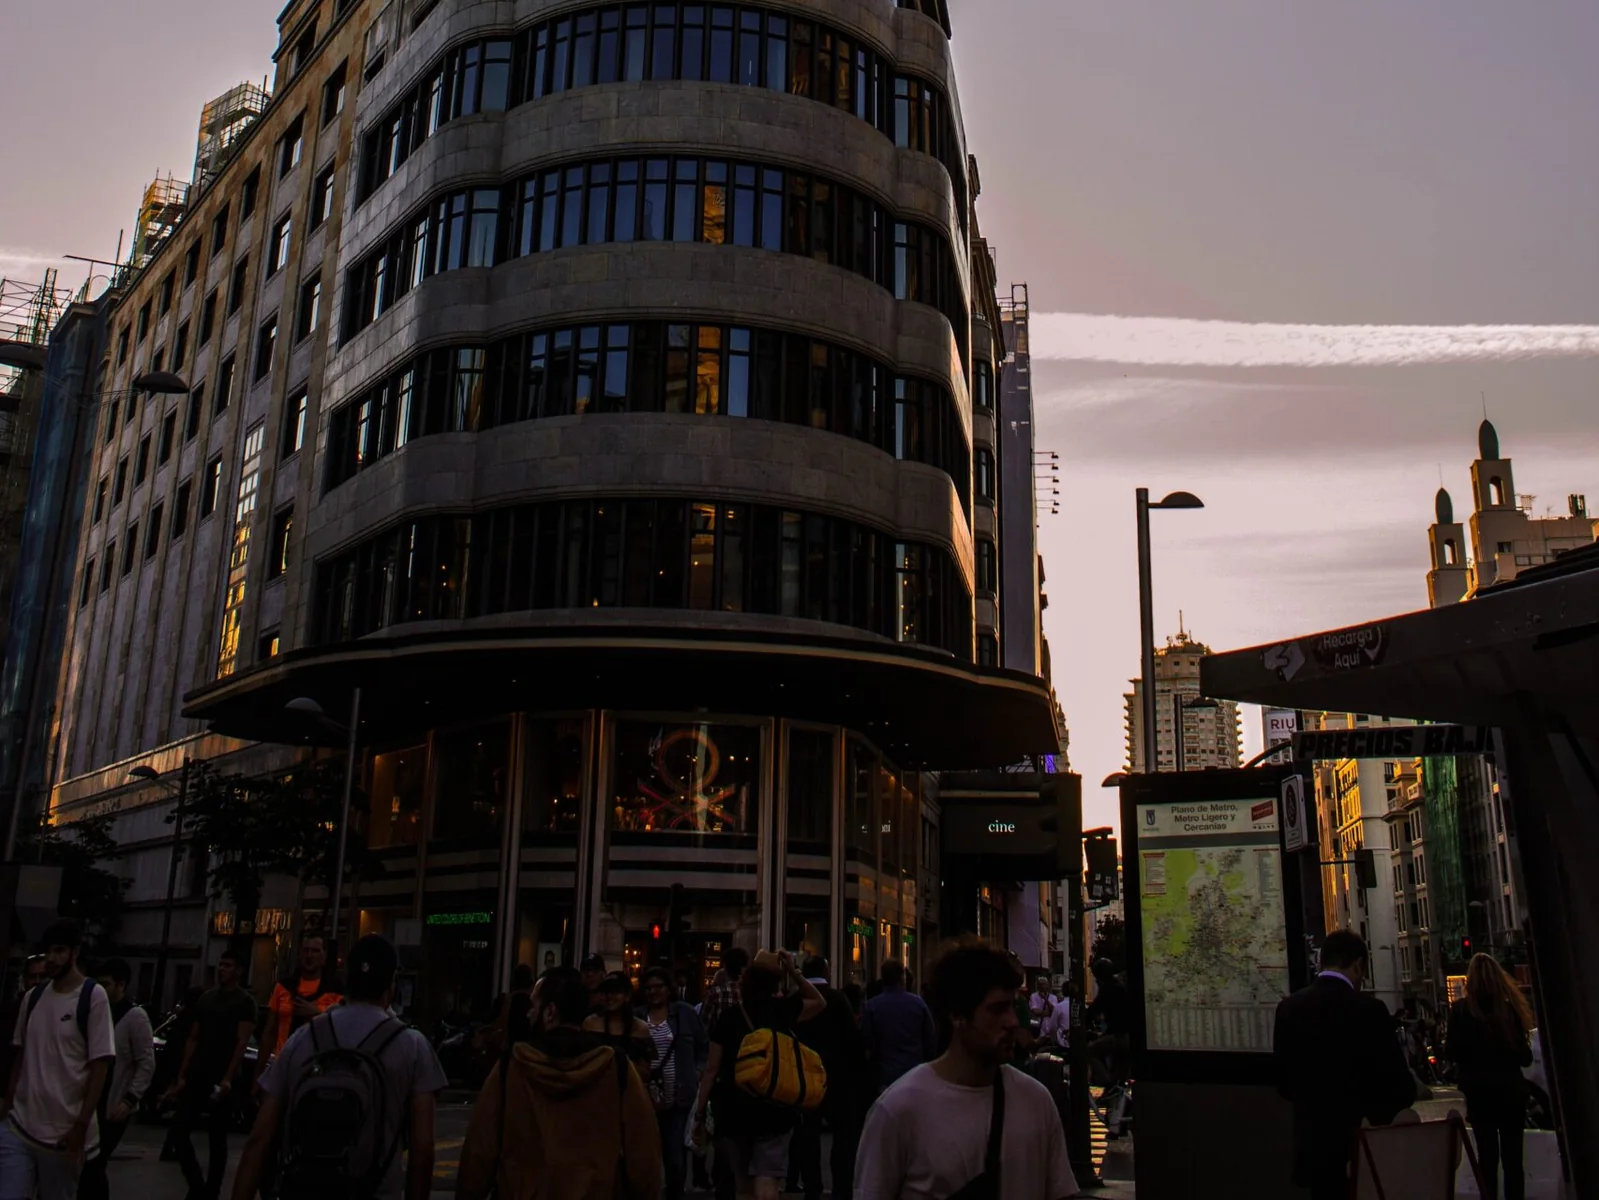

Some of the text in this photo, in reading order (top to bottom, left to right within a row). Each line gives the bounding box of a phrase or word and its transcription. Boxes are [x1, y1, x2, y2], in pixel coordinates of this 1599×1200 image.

[1323, 628, 1373, 649] Recarga
[1271, 718, 1295, 729] RIU
[1298, 729, 1414, 758] PRECIOS
[1171, 806, 1195, 814] Plano
[1174, 813, 1236, 822] Metro Ligero y
[988, 820, 1015, 833] cine
